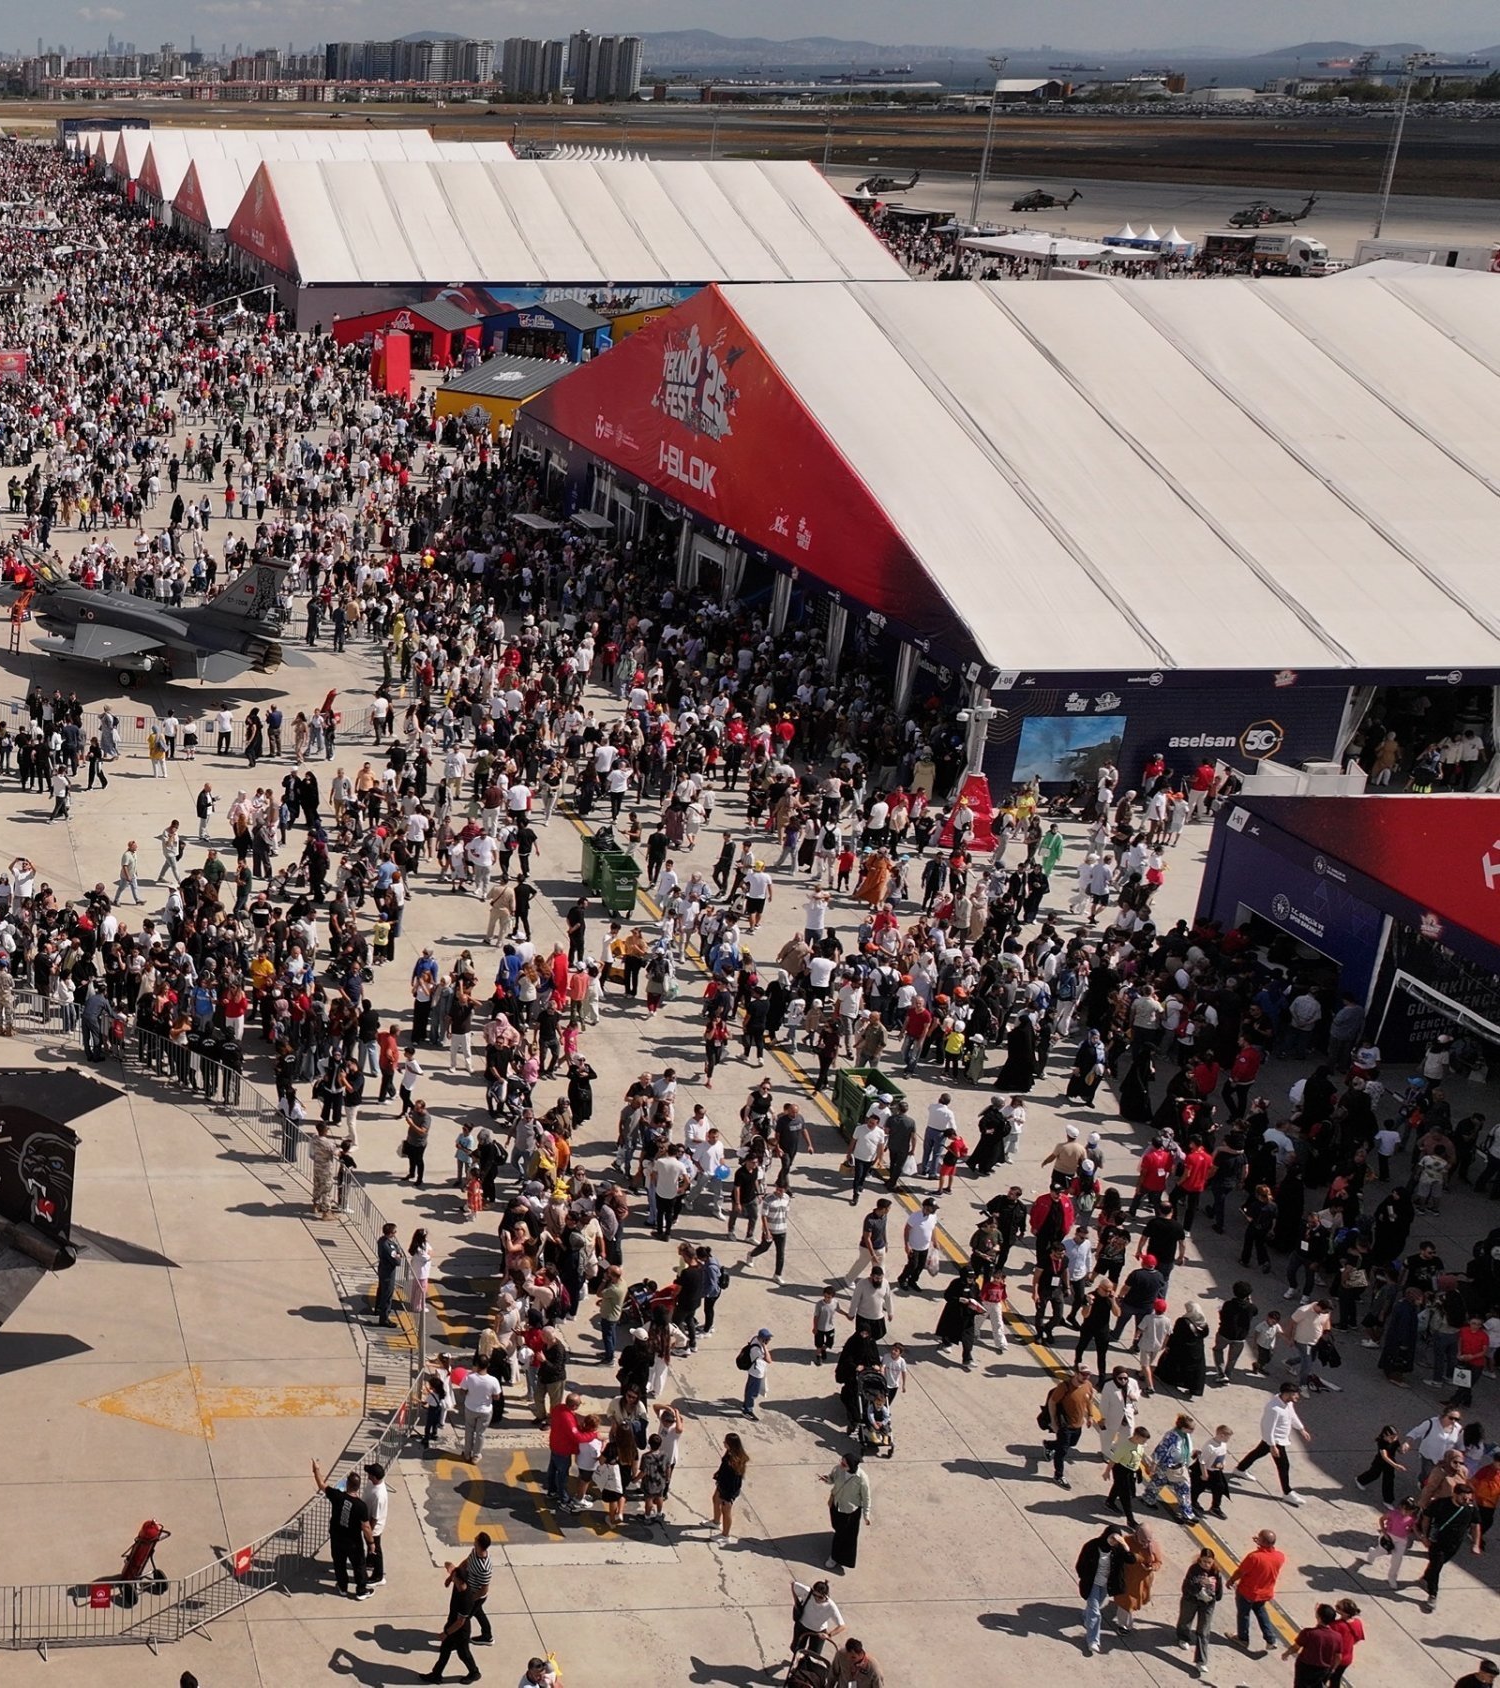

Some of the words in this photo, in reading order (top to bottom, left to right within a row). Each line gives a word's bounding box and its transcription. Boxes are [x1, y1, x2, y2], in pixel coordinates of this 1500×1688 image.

[663, 347, 702, 386] TEKNO
[665, 383, 697, 422] FEST
[658, 440, 717, 498] I-BLOK
[1168, 733, 1236, 748] aselsan
